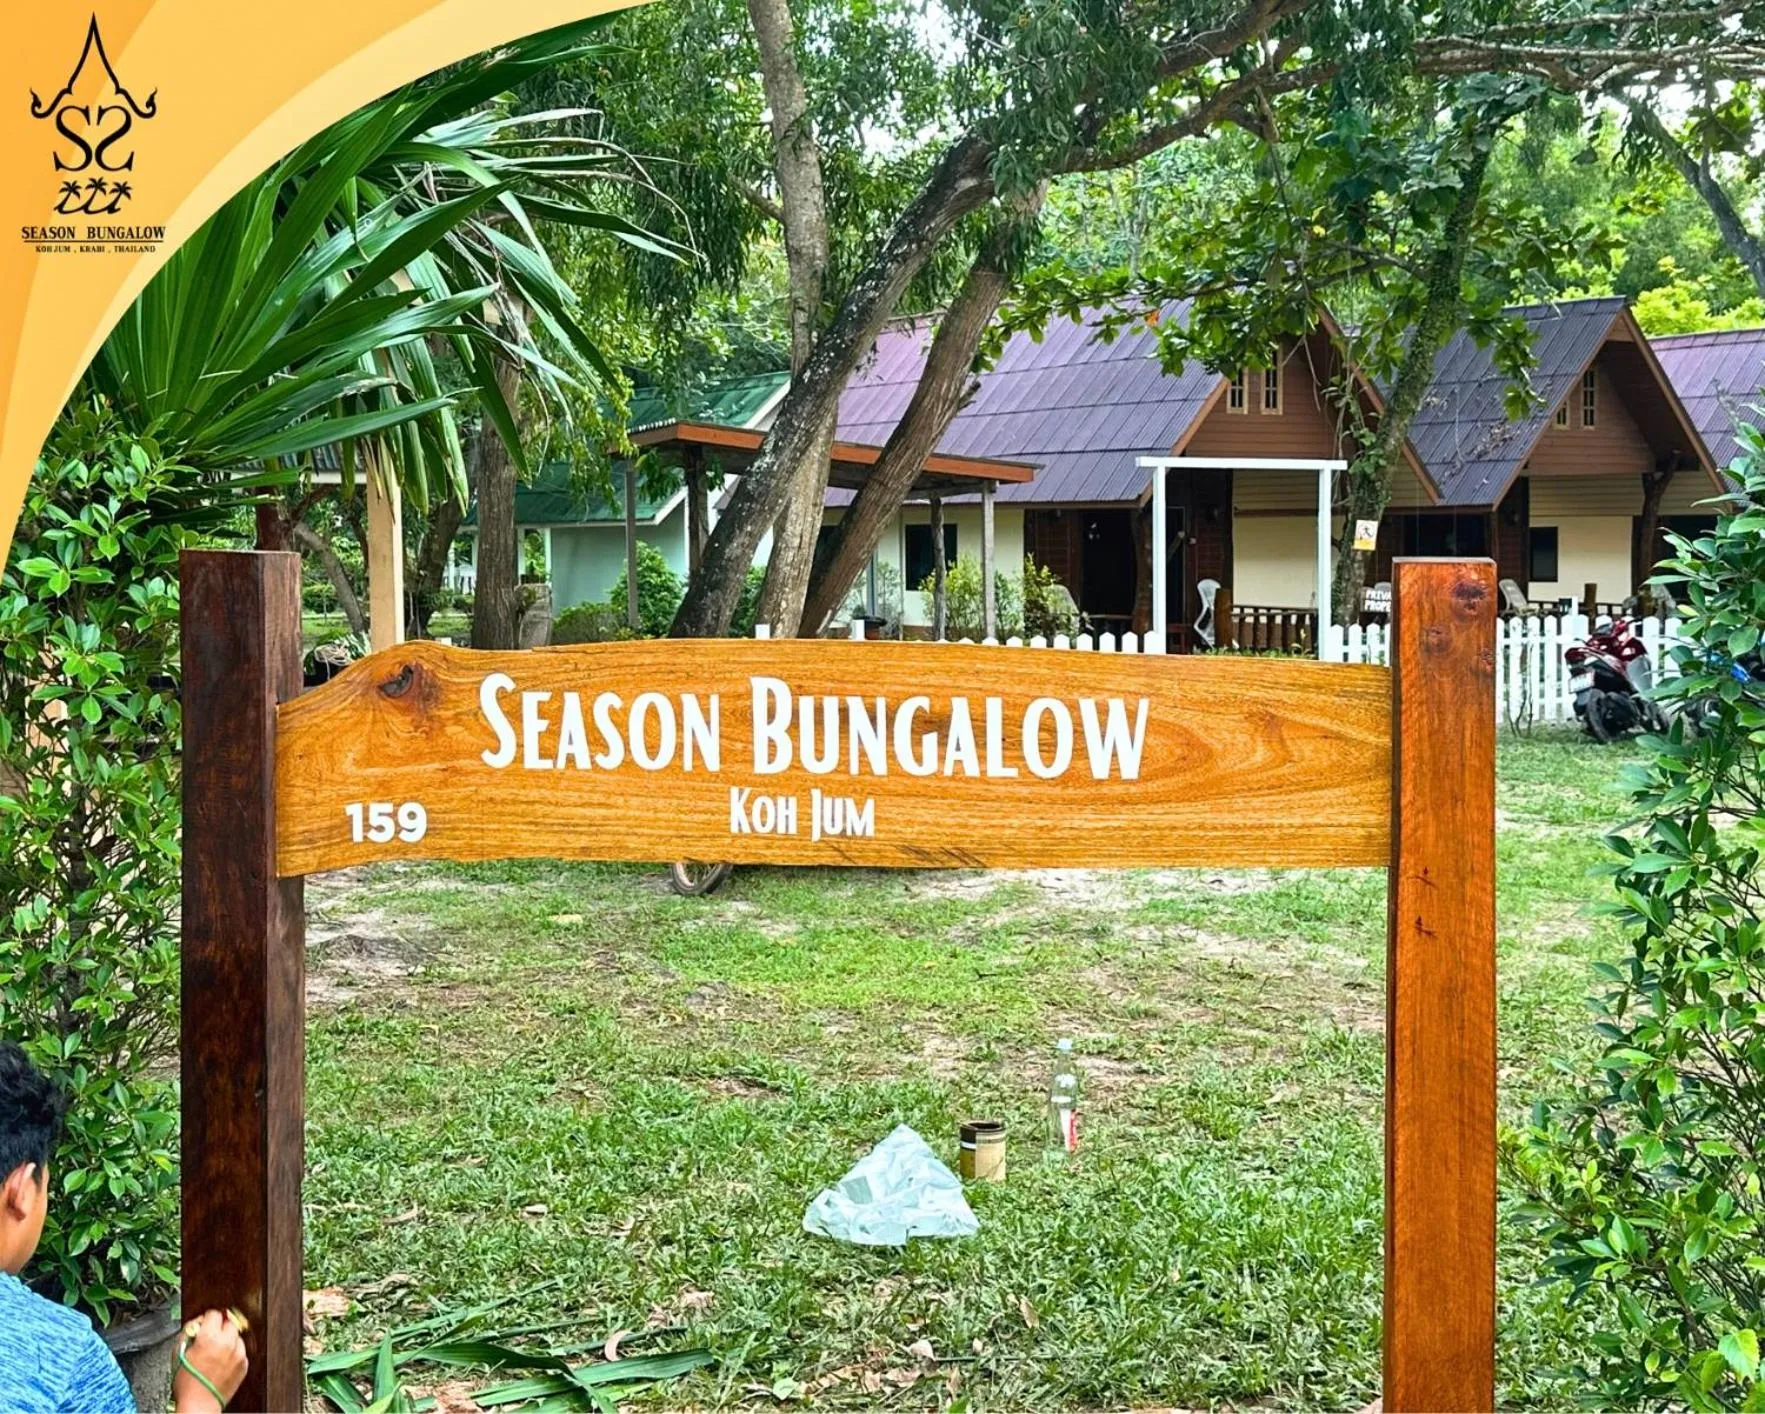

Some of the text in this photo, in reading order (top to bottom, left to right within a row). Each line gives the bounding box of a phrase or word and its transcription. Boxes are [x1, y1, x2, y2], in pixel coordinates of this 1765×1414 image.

[480, 673, 1149, 779] SEASON BUNGALOW
[346, 802, 427, 842] 159
[730, 787, 874, 841] KOH JUM
